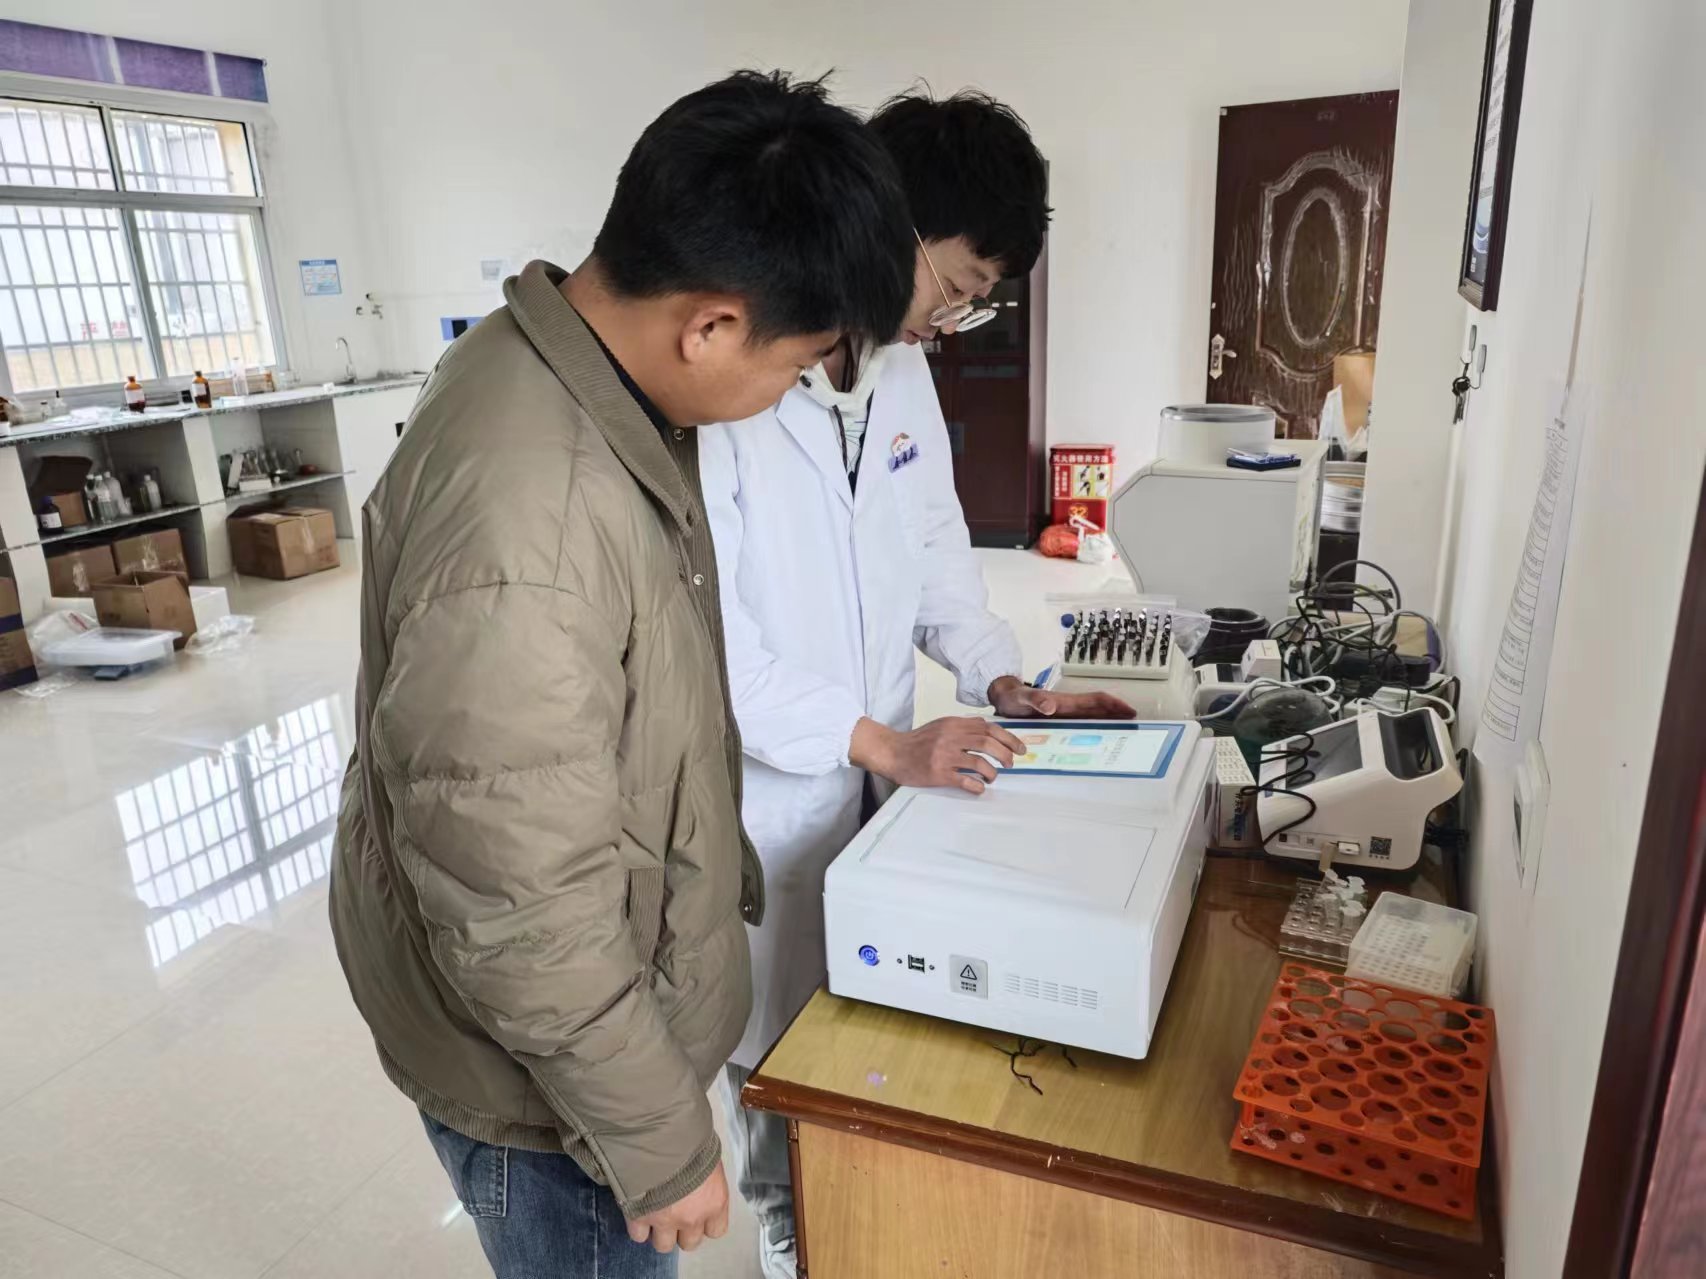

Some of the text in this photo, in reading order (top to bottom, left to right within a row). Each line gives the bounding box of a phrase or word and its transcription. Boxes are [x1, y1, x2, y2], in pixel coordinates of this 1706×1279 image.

[1053, 454, 1109, 463] 灭火器使用方法
